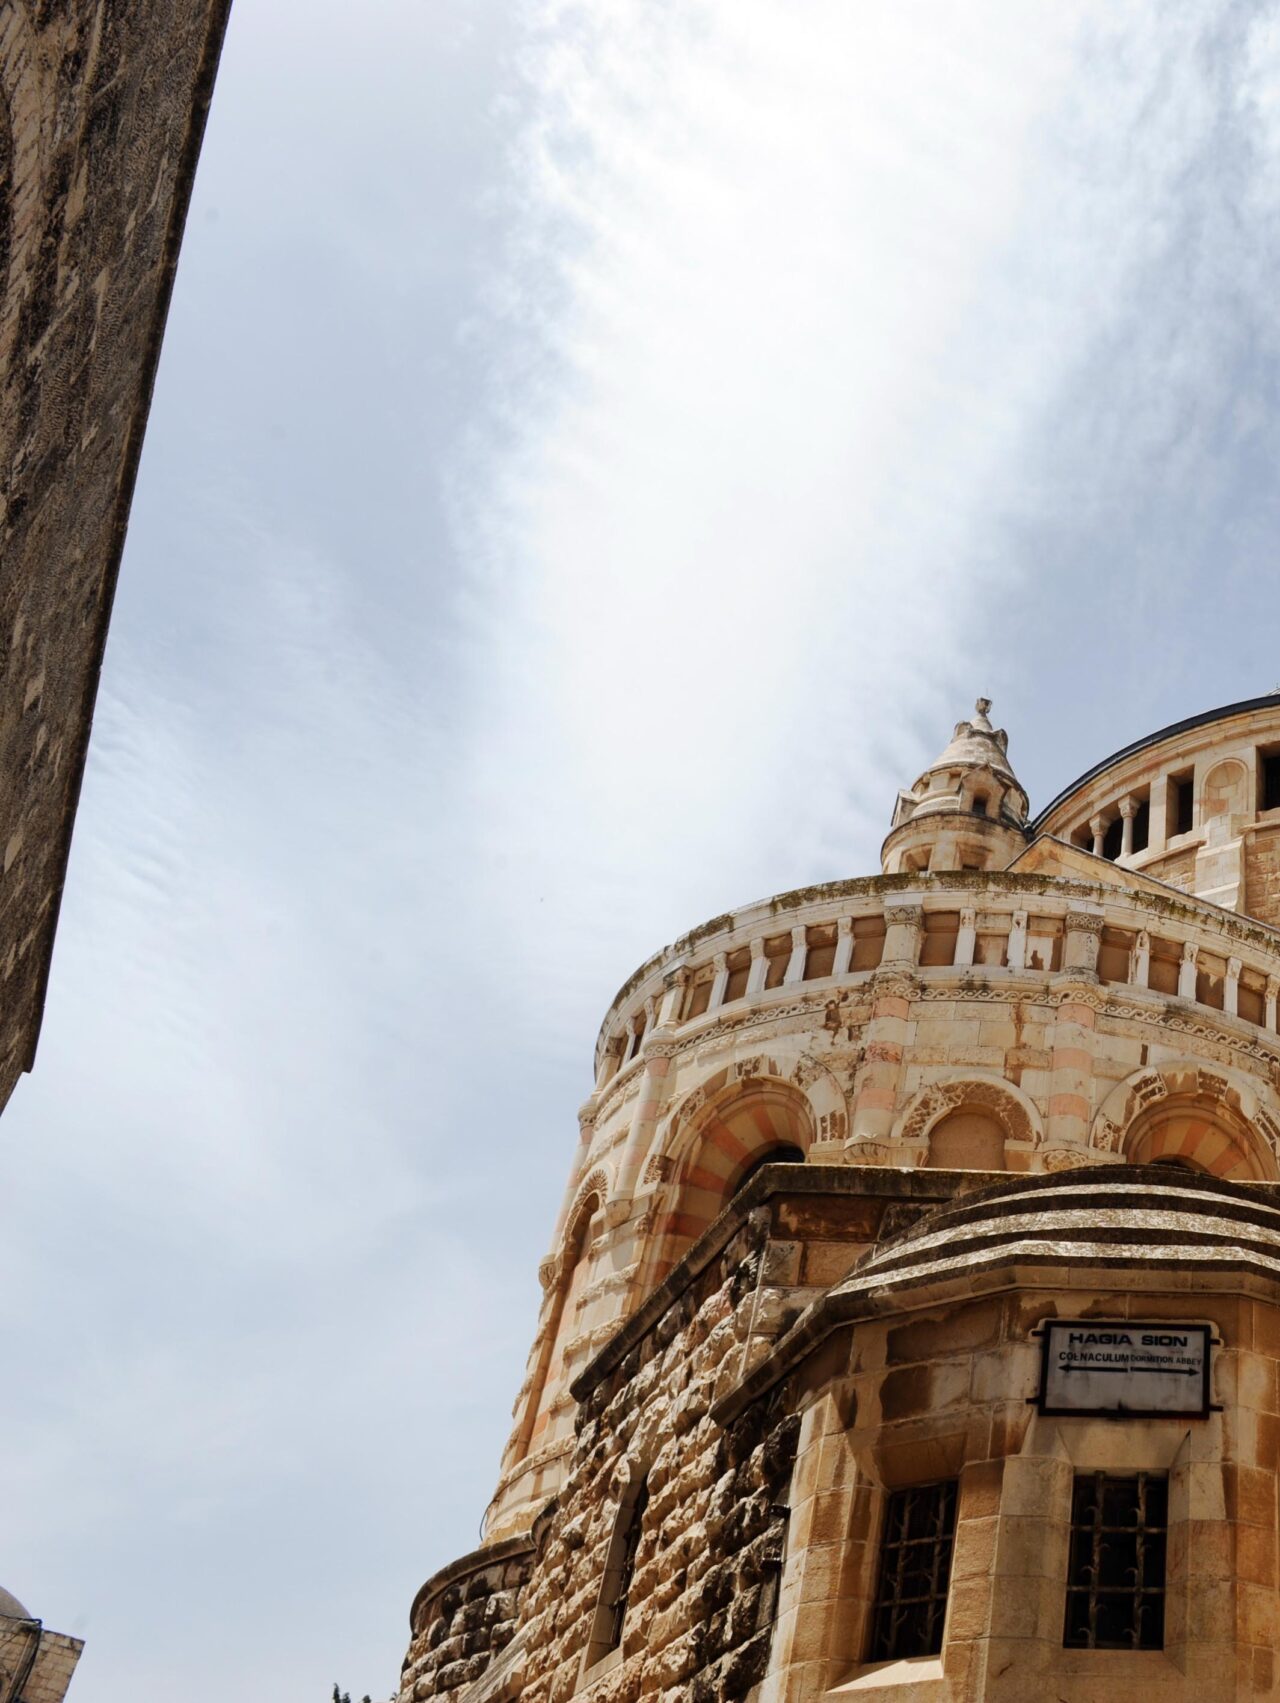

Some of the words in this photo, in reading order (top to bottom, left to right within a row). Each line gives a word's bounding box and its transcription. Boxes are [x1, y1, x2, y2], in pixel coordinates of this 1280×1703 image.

[1069, 1333, 1133, 1345] HAGIA
[1141, 1335, 1188, 1347] SION
[1130, 1354, 1174, 1363] DORMITION
[1176, 1357, 1202, 1365] ABBEY
